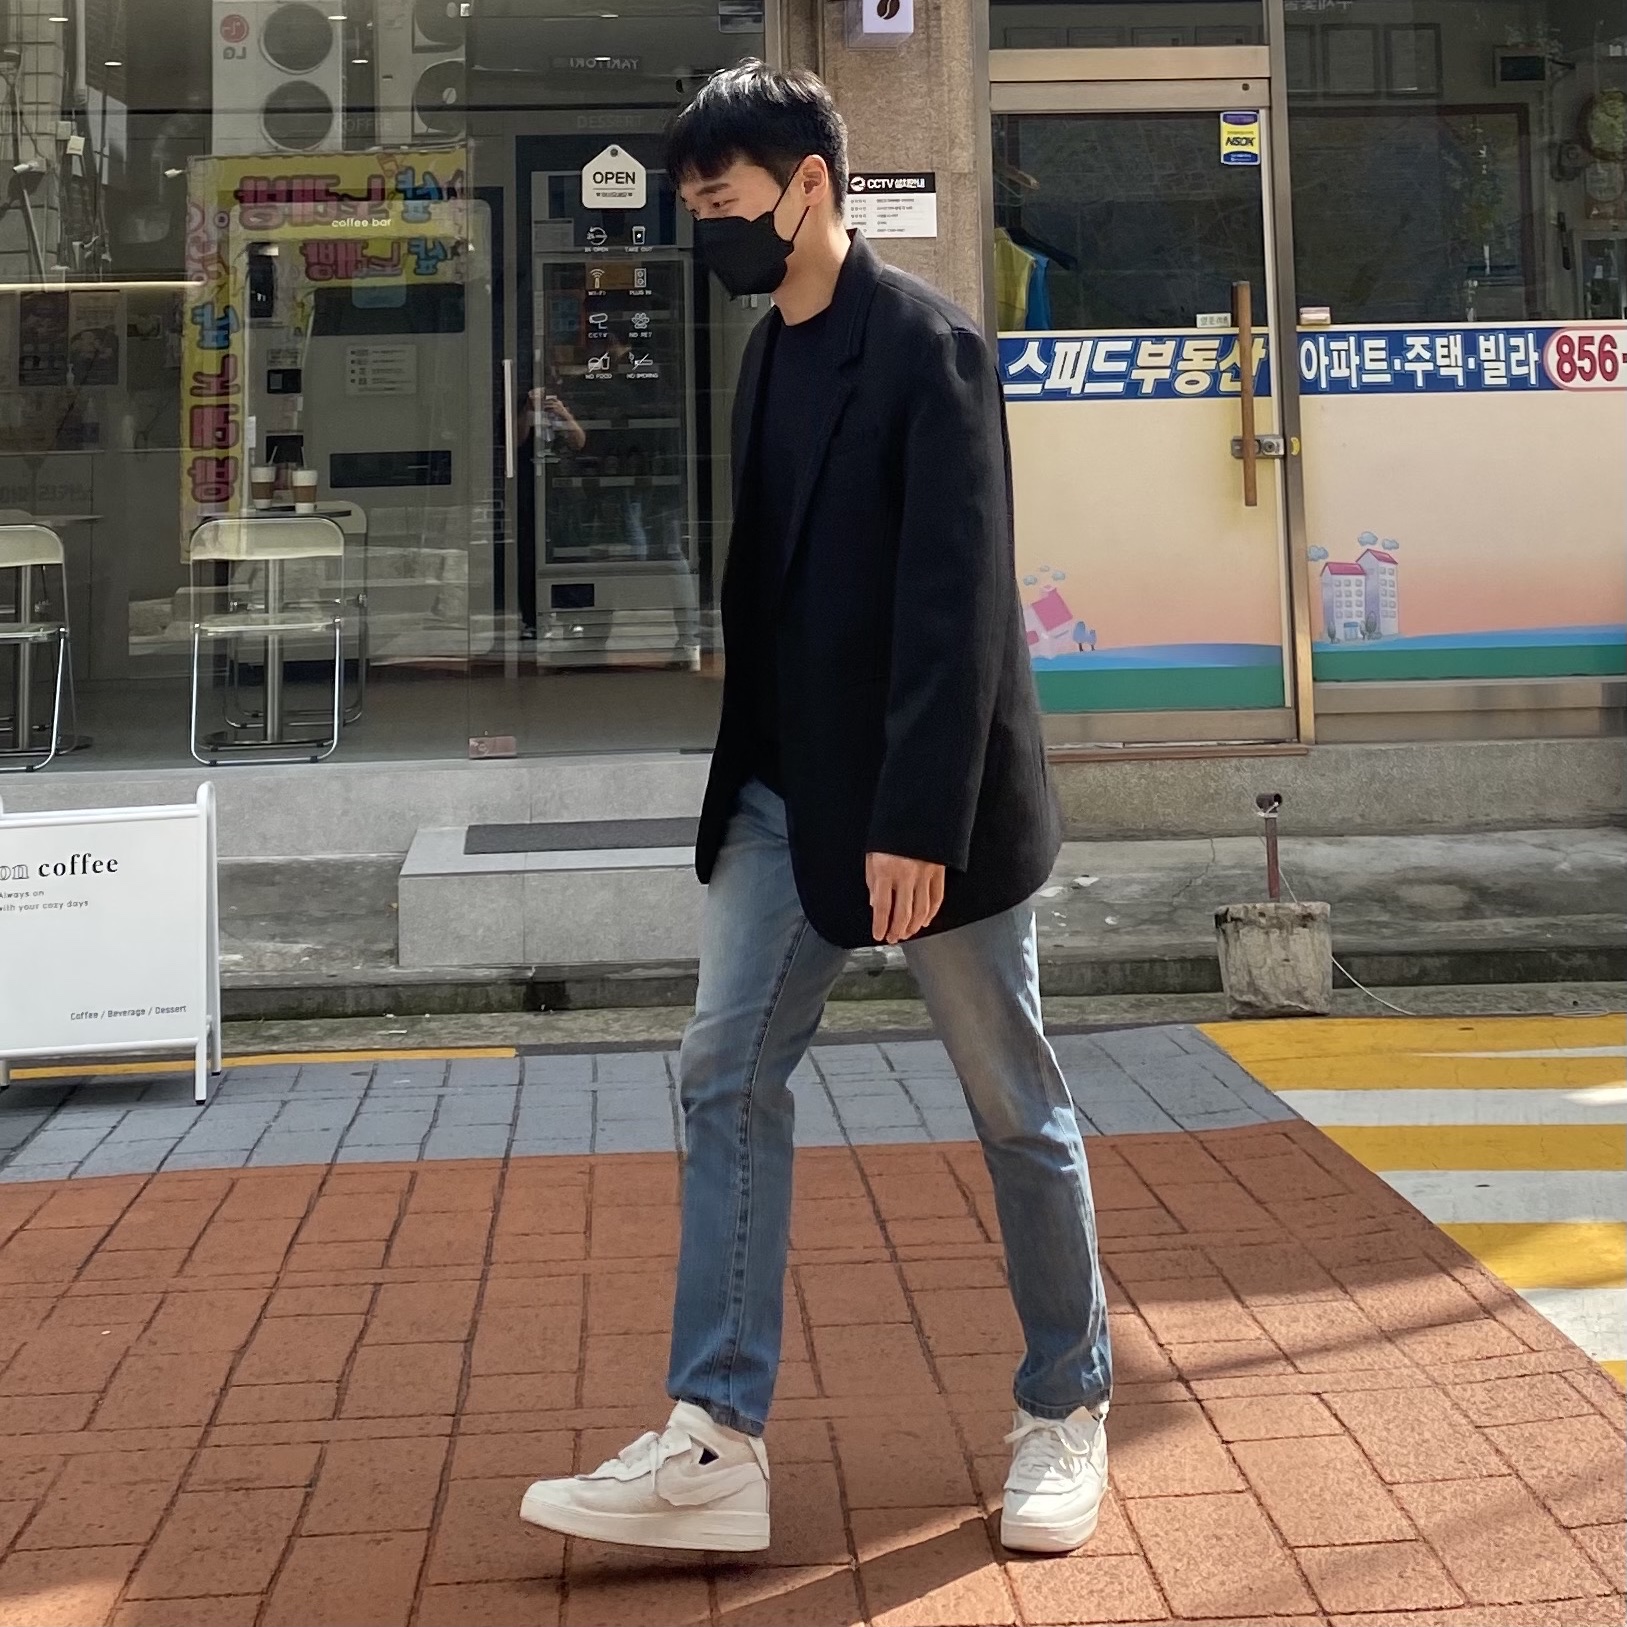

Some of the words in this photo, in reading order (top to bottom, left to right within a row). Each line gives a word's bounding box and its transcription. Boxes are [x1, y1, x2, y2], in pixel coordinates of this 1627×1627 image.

[592, 171, 636, 185] OPEN
[867, 178, 894, 189] CCTV
[331, 217, 369, 228] coffee
[371, 217, 392, 227] bar
[1003, 338, 1266, 395] 스피드부동산
[38, 853, 119, 877] coffee
[19, 903, 40, 912] your
[42, 902, 64, 910] cozy
[66, 900, 89, 908] days
[70, 1011, 99, 1021] Coffee
[107, 1008, 146, 1018] Beverage
[155, 1005, 187, 1015] Dessert
